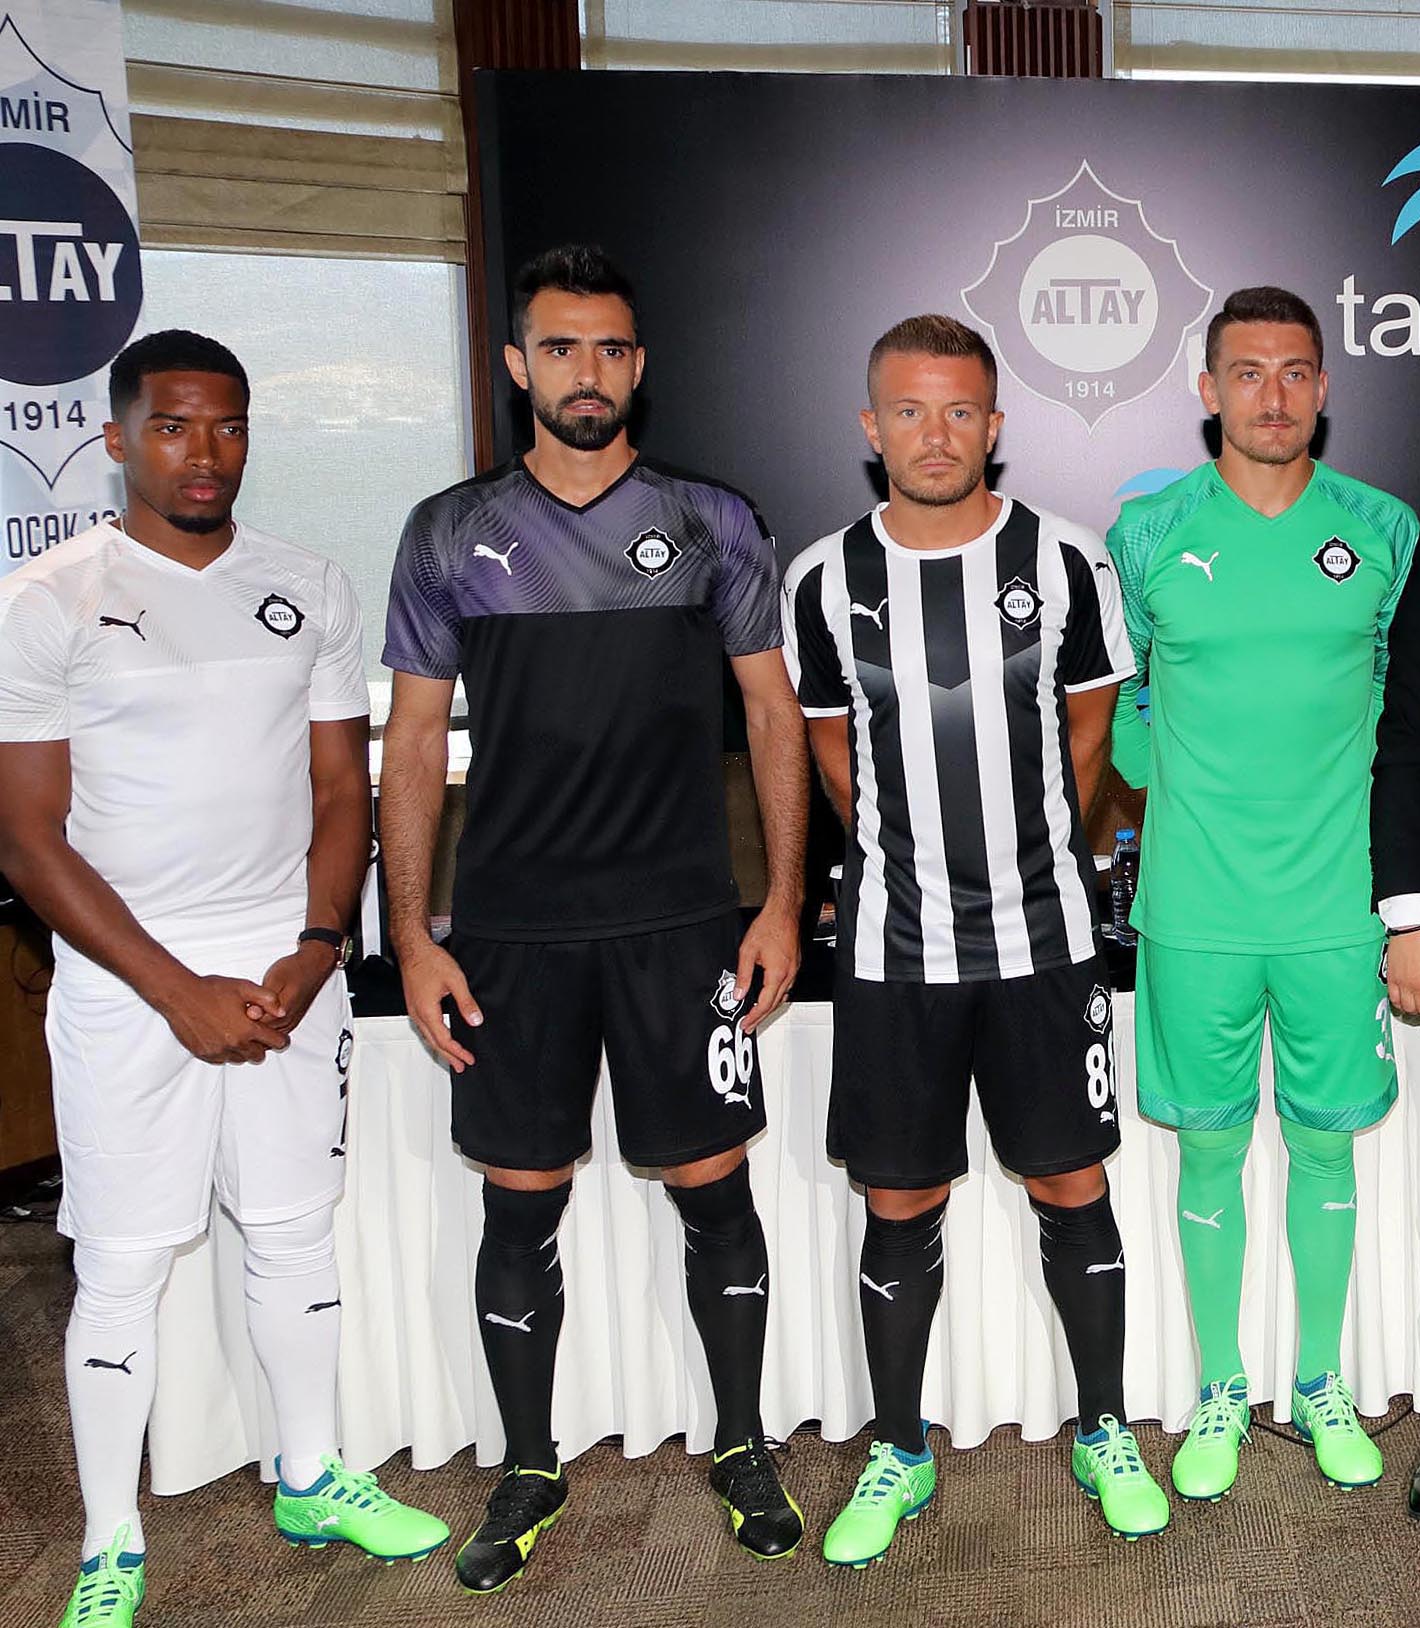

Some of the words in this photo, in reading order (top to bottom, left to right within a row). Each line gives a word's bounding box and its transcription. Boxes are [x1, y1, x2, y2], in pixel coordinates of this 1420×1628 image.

[2, 91, 70, 133] MİR
[1055, 205, 1119, 228] İZMİR
[0, 219, 124, 301] TAY
[1031, 278, 1145, 325] ALTAY
[1064, 380, 1116, 399] 1914
[4, 400, 86, 431] 1914
[7, 513, 77, 559] OCAK
[640, 547, 666, 559] ALTAY
[1007, 598, 1031, 609] ALTAY
[708, 1015, 753, 1095] 66
